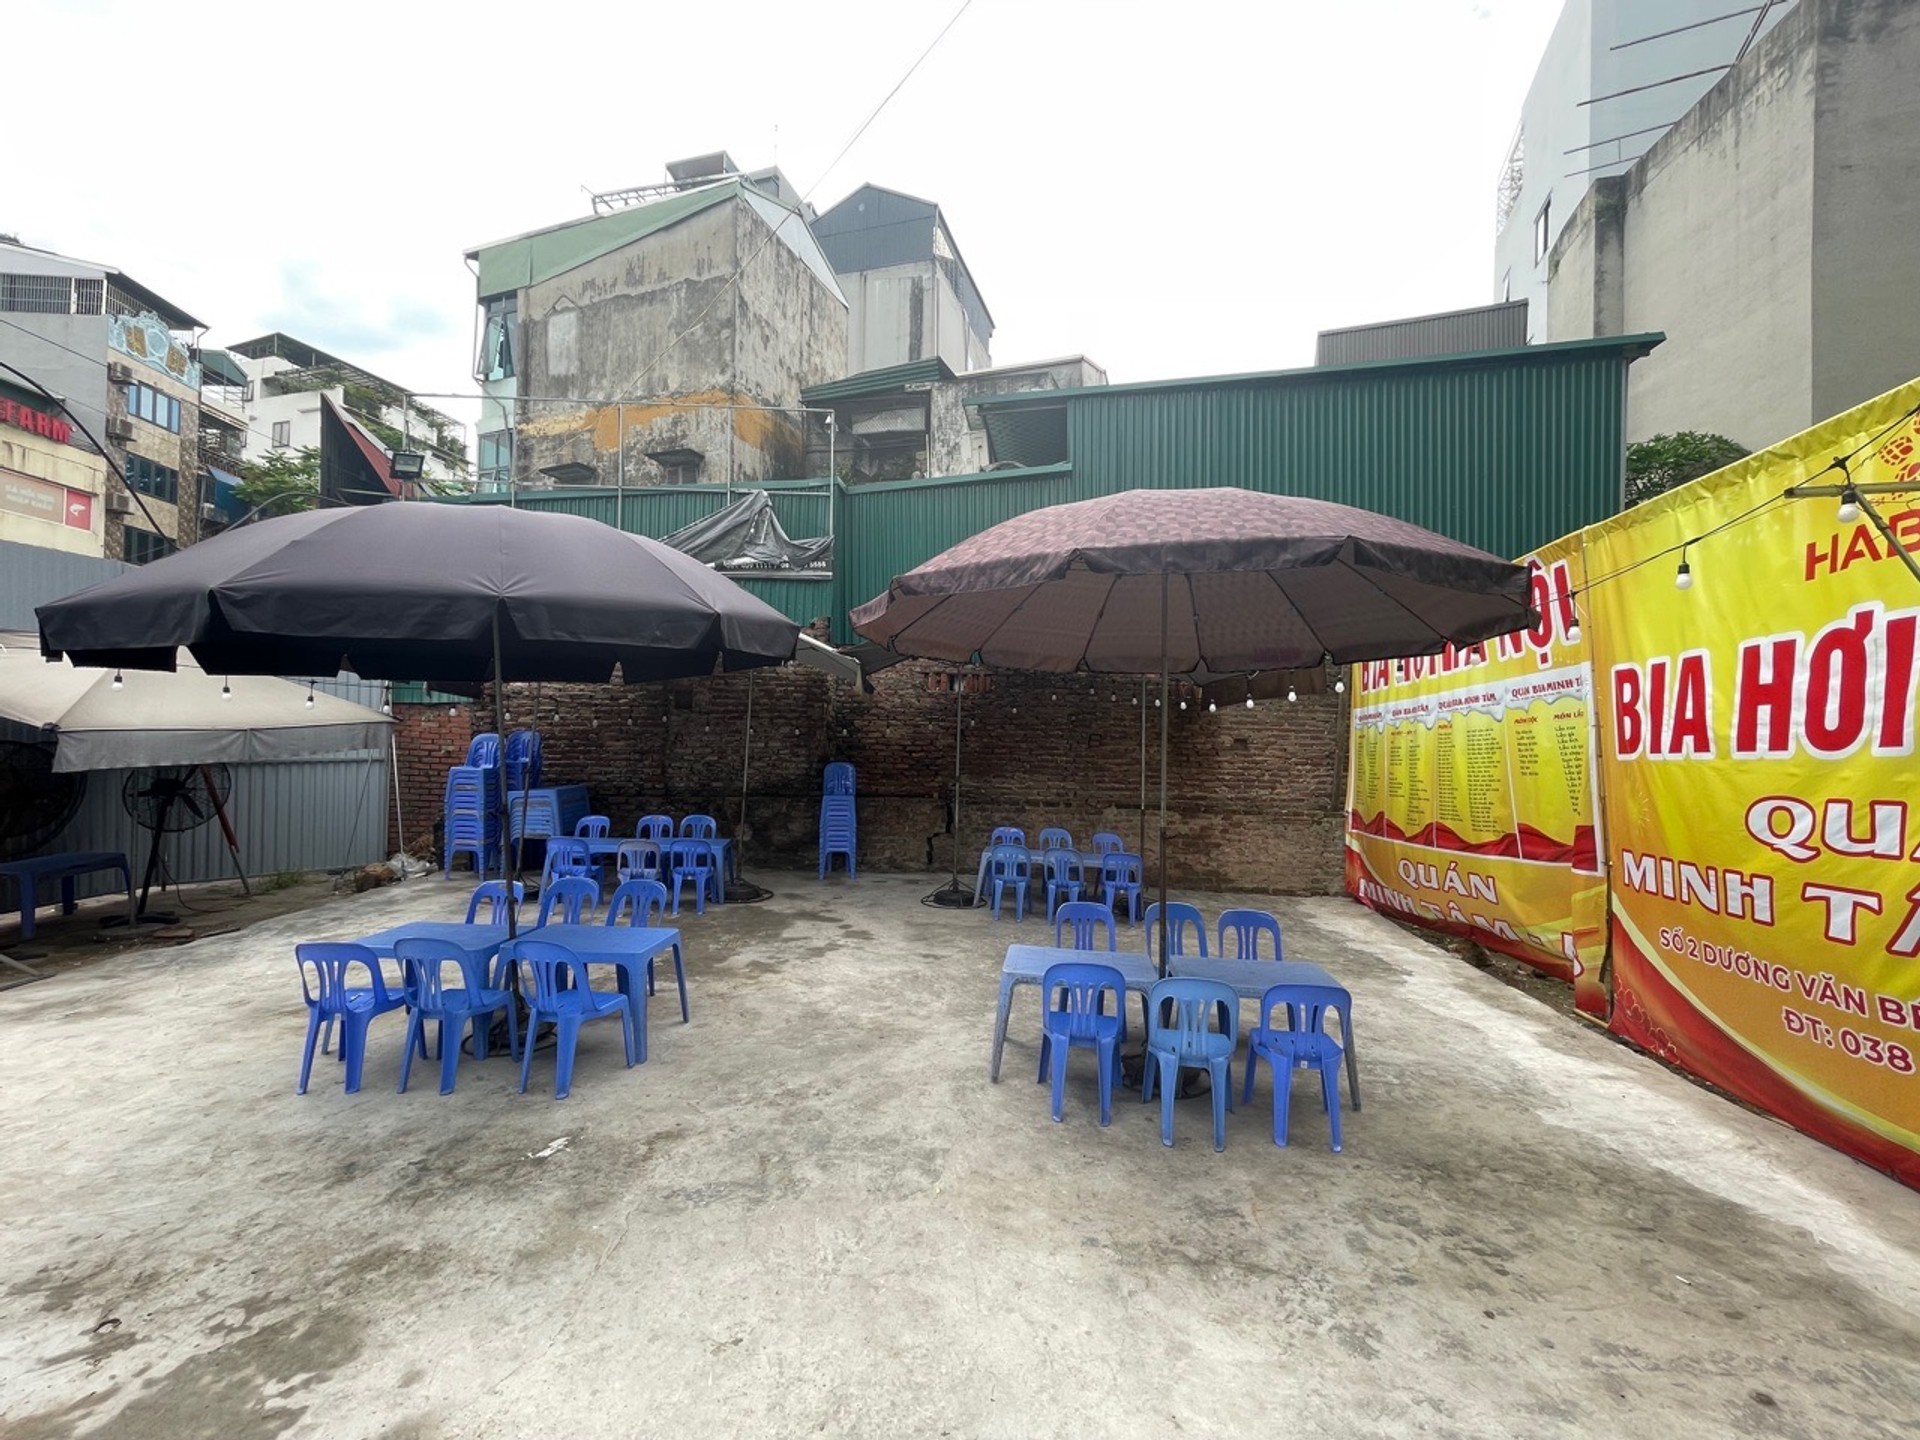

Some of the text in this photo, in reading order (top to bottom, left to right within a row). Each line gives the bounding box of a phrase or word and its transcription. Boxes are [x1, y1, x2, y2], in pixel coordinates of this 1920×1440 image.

[1614, 609, 1917, 755] BIA HƠI
[1745, 796, 1920, 863] QU
[1398, 858, 1498, 904] QUÁN
[1622, 849, 1775, 926] MINH
[1660, 927, 1684, 952] SỐ
[1687, 939, 1699, 958] 2
[1703, 943, 1791, 990] DƯƠNG
[1797, 973, 1867, 1016] VĂN
[1784, 1009, 1913, 1073] ĐT: 038
